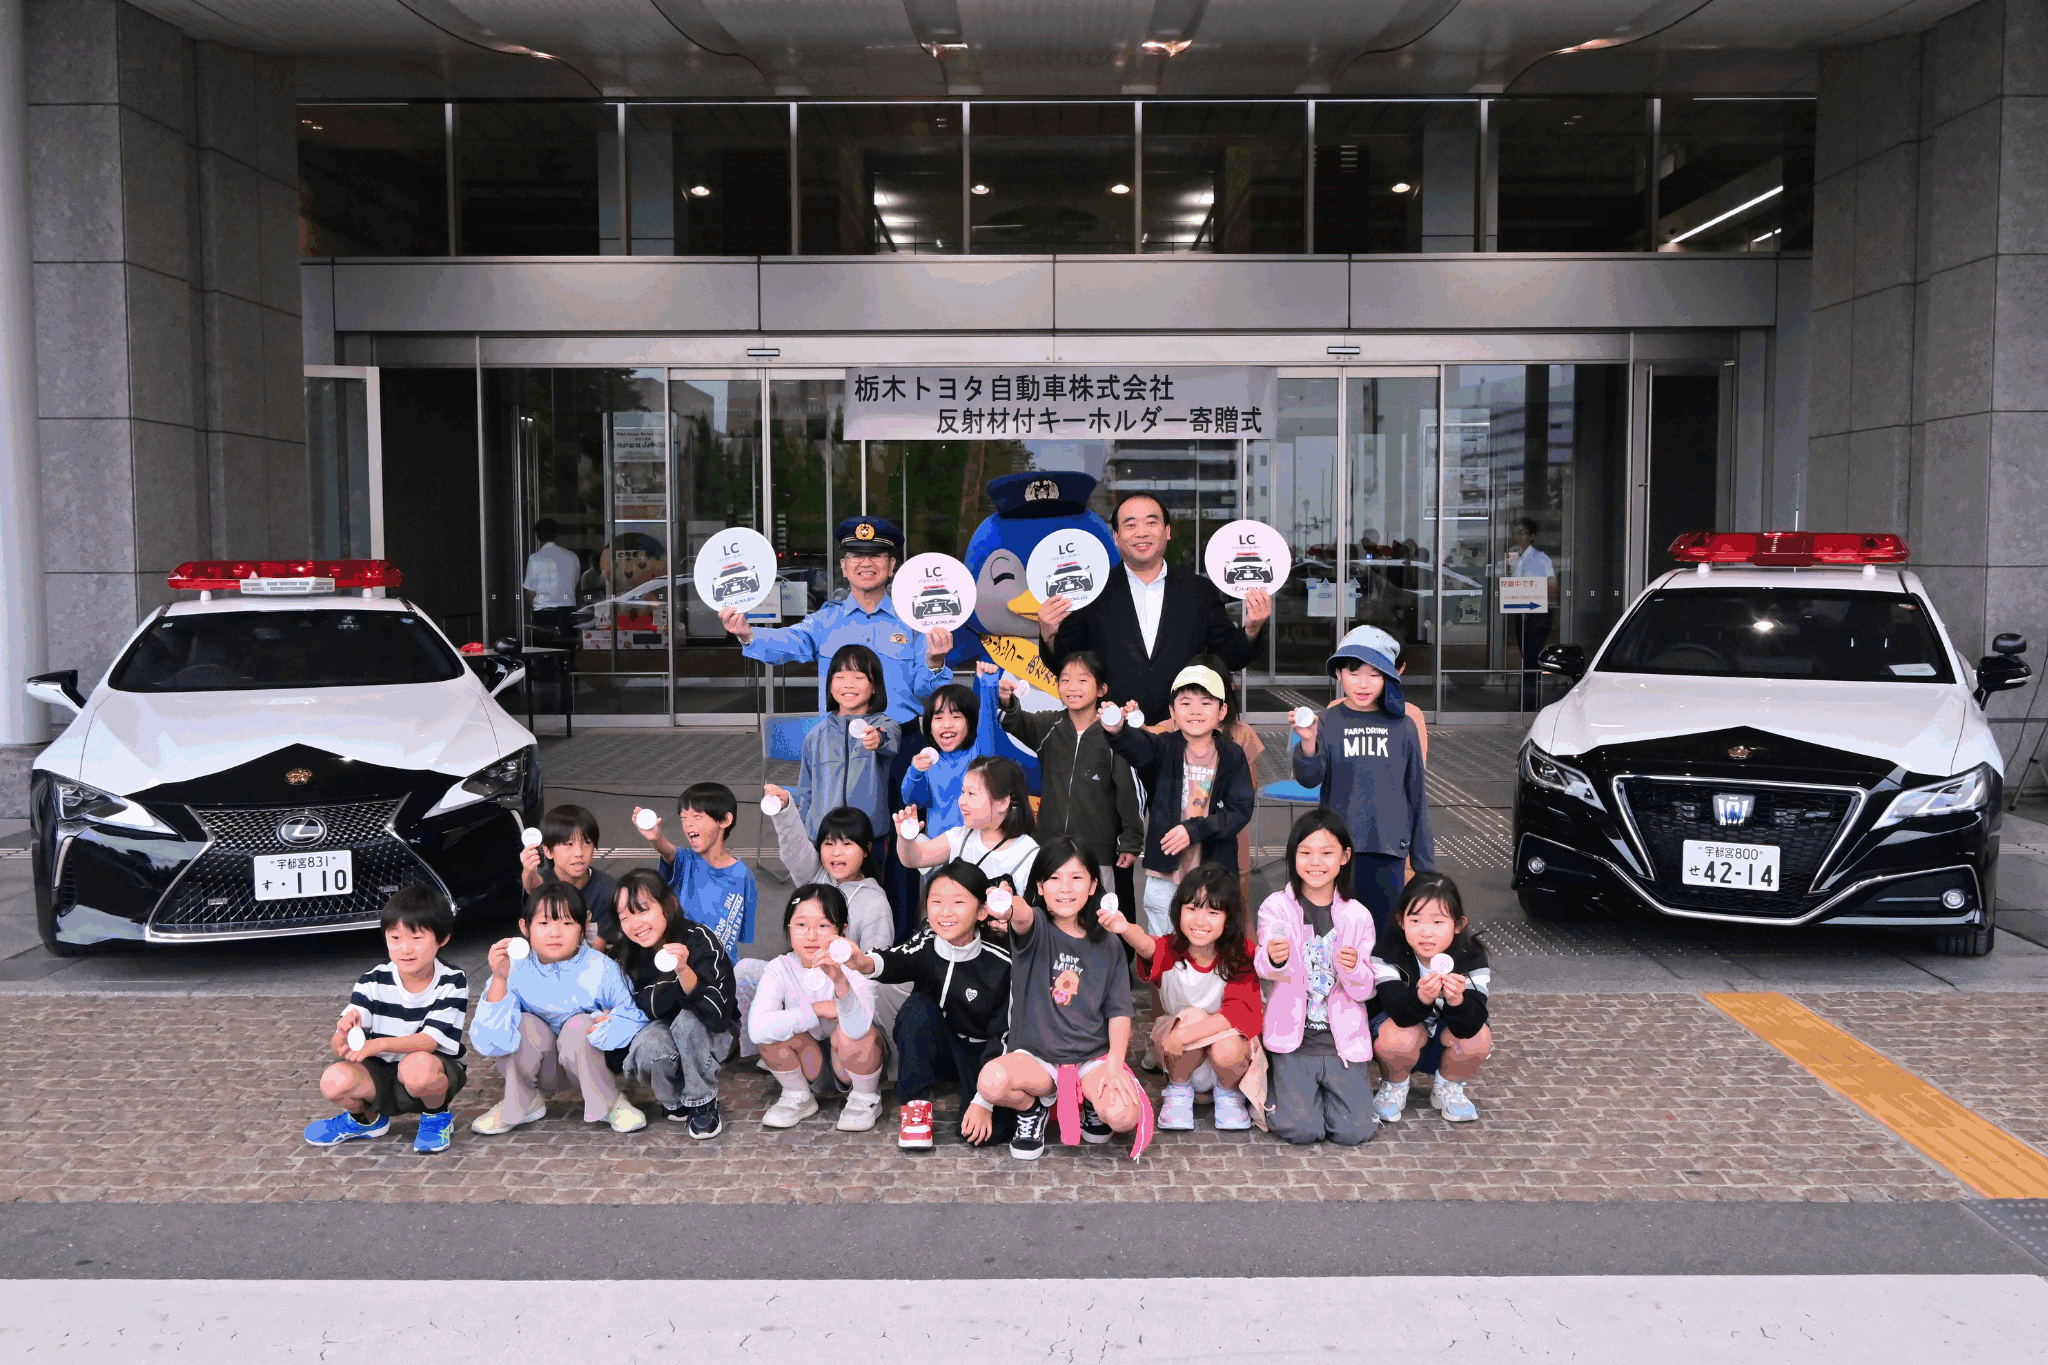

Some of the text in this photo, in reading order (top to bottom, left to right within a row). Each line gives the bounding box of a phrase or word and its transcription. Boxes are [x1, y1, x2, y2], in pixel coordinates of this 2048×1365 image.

[854, 373, 1175, 402] 栃木トヨタ自動車株式会社
[936, 406, 1262, 435] 反射材付キーホルダー寄贈式
[1239, 534, 1256, 545] LC
[723, 542, 740, 556] LC
[1058, 542, 1075, 555] LC
[925, 566, 942, 578] LC
[1344, 726, 1389, 736] FARM DRINK
[1343, 736, 1389, 758] MILK
[1705, 846, 1759, 860] 宇都宮800
[277, 855, 329, 870] 宇都宮831
[1688, 860, 1773, 887] せ 42-14
[723, 892, 736, 910] THE
